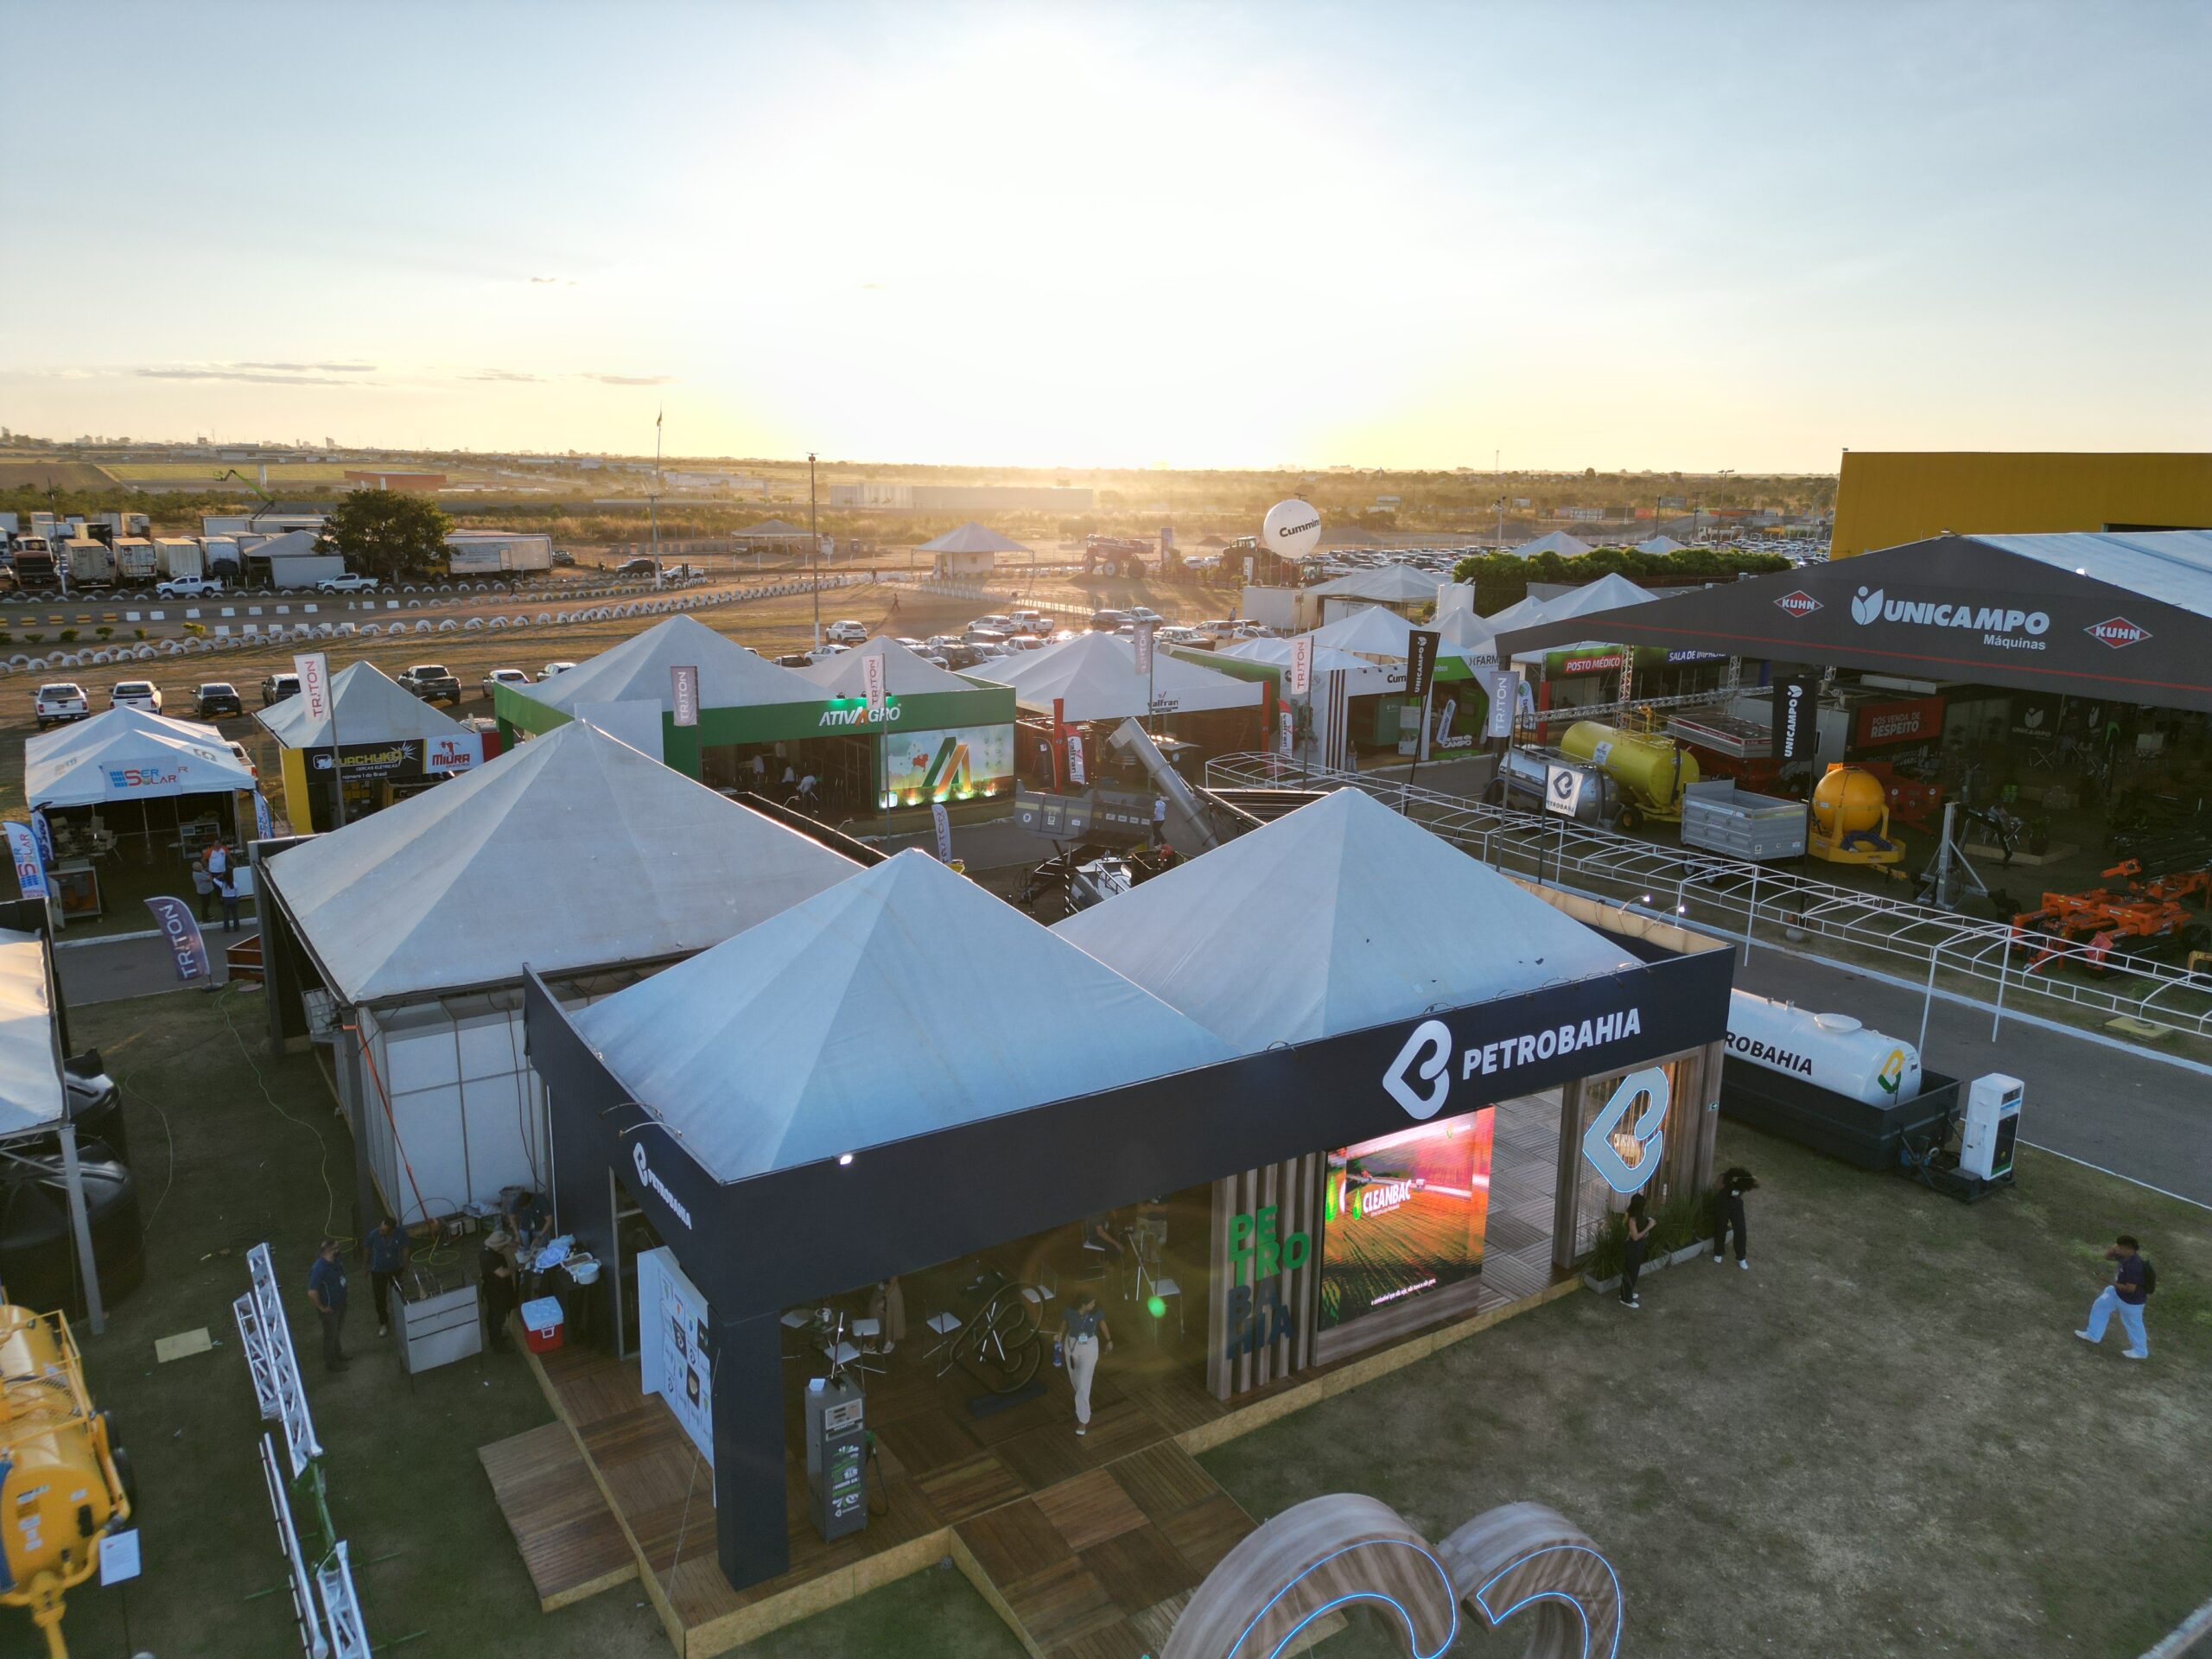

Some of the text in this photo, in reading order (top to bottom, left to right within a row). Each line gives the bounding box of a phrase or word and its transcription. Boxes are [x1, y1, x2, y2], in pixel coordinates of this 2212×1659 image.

[1782, 598, 1815, 610] KUHN
[1884, 600, 2050, 635] UNICAMPO
[1669, 651, 1686, 662] SALA
[1687, 650, 1696, 660] DE
[1983, 633, 2047, 651] Máquinas
[2094, 625, 2141, 640] KUHN
[869, 659, 878, 706] TRITON
[1297, 641, 1306, 690] TRITON
[1414, 646, 1424, 693] UNICAMPO
[1567, 656, 1621, 671] POSTO MÉDICO
[304, 660, 324, 718] TRITON
[677, 671, 690, 722] TRITON
[1495, 677, 1508, 732] TRITON
[1784, 698, 1798, 758] UNICAMPO
[1871, 720, 1919, 738] RESPEITO
[159, 904, 197, 979] TRITON
[1462, 1007, 1642, 1080] PETROBAHIA
[1725, 1031, 1813, 1077] ROBAHIA
[647, 1168, 692, 1230] PETROBAHIA
[1363, 1179, 1411, 1214] CLEANBAC
[1229, 1205, 1278, 1253] PE
[1229, 1231, 1311, 1287] TRO
[1227, 1278, 1280, 1319] BA
